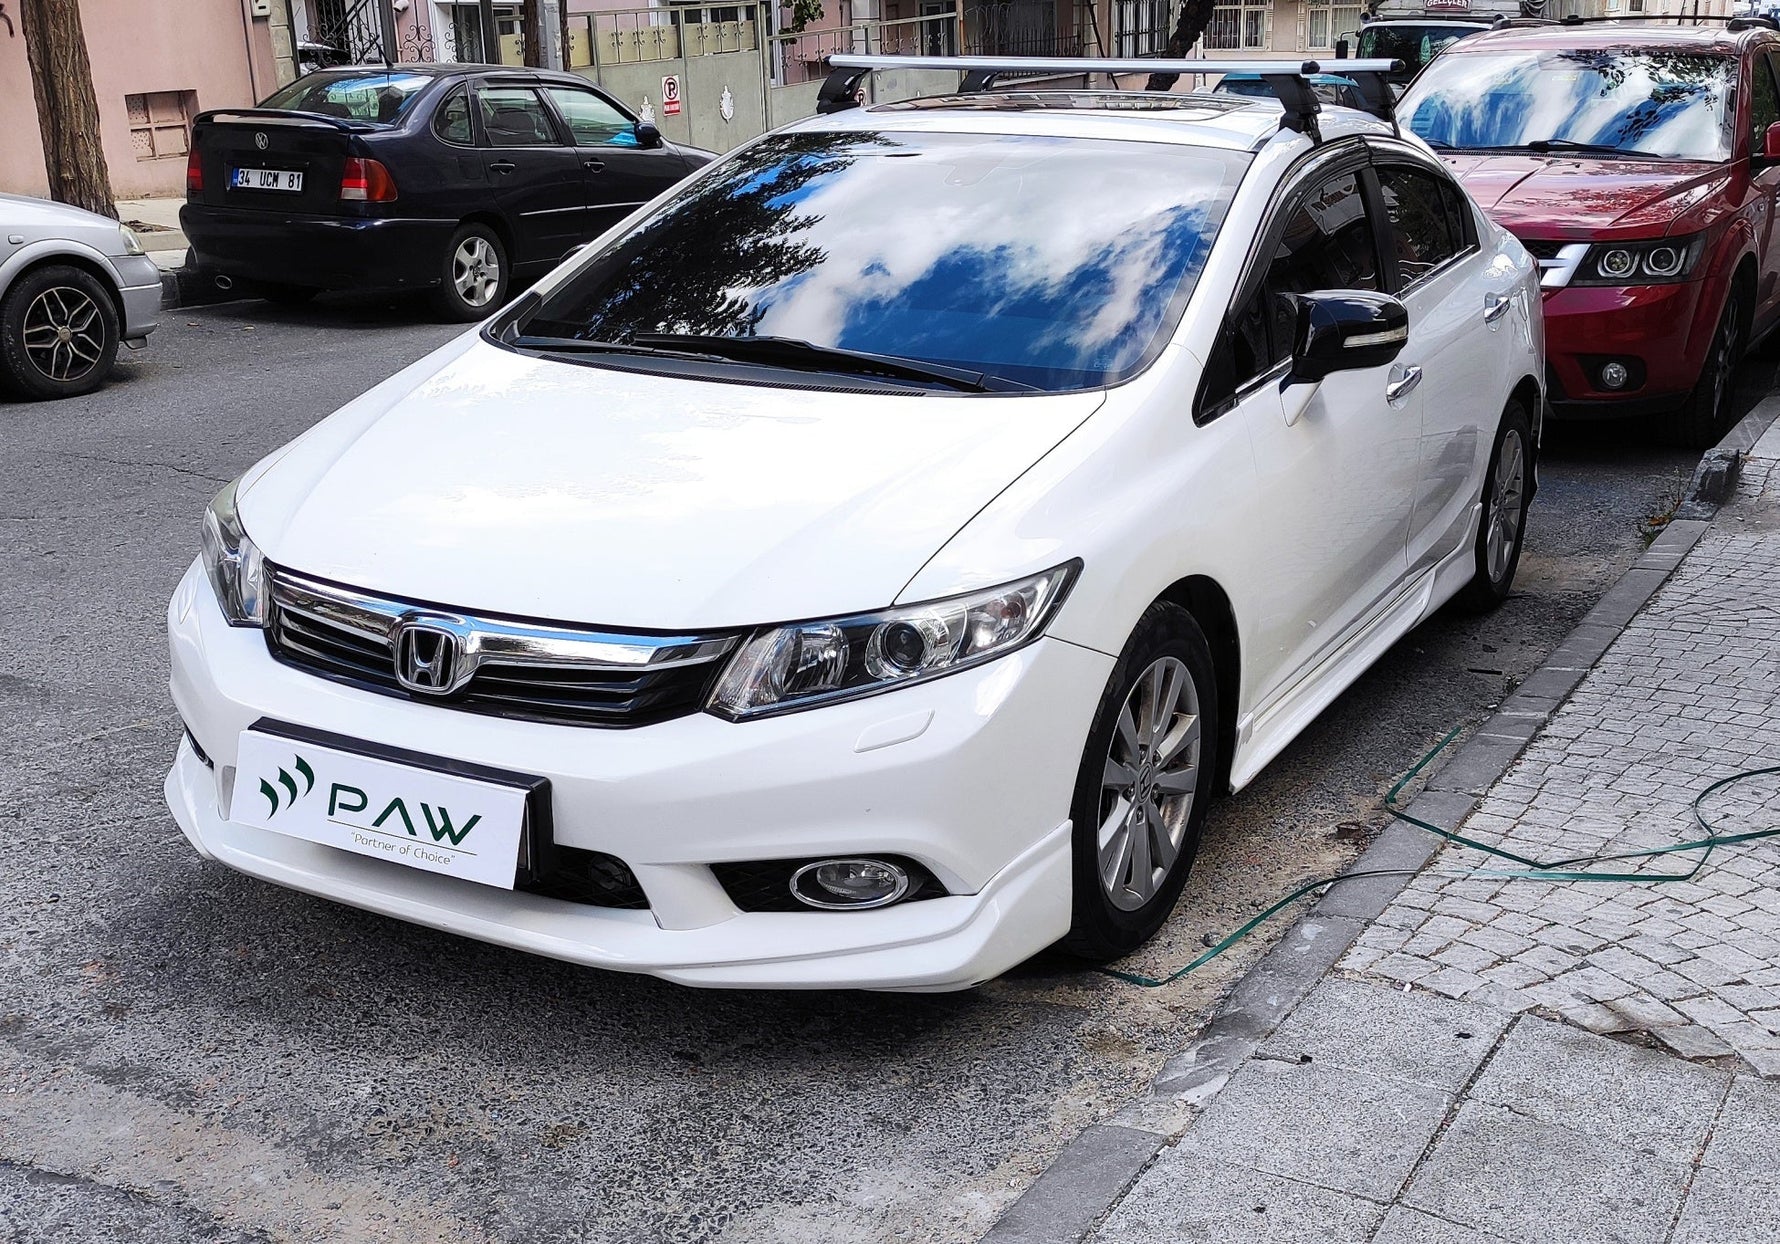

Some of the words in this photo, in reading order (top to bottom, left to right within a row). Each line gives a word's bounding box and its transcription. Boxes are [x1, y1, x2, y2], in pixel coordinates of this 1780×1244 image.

[238, 170, 250, 186] 34
[259, 171, 280, 188] UCM
[288, 173, 301, 189] 81
[327, 782, 483, 846] PAW
[399, 845, 411, 856] of
